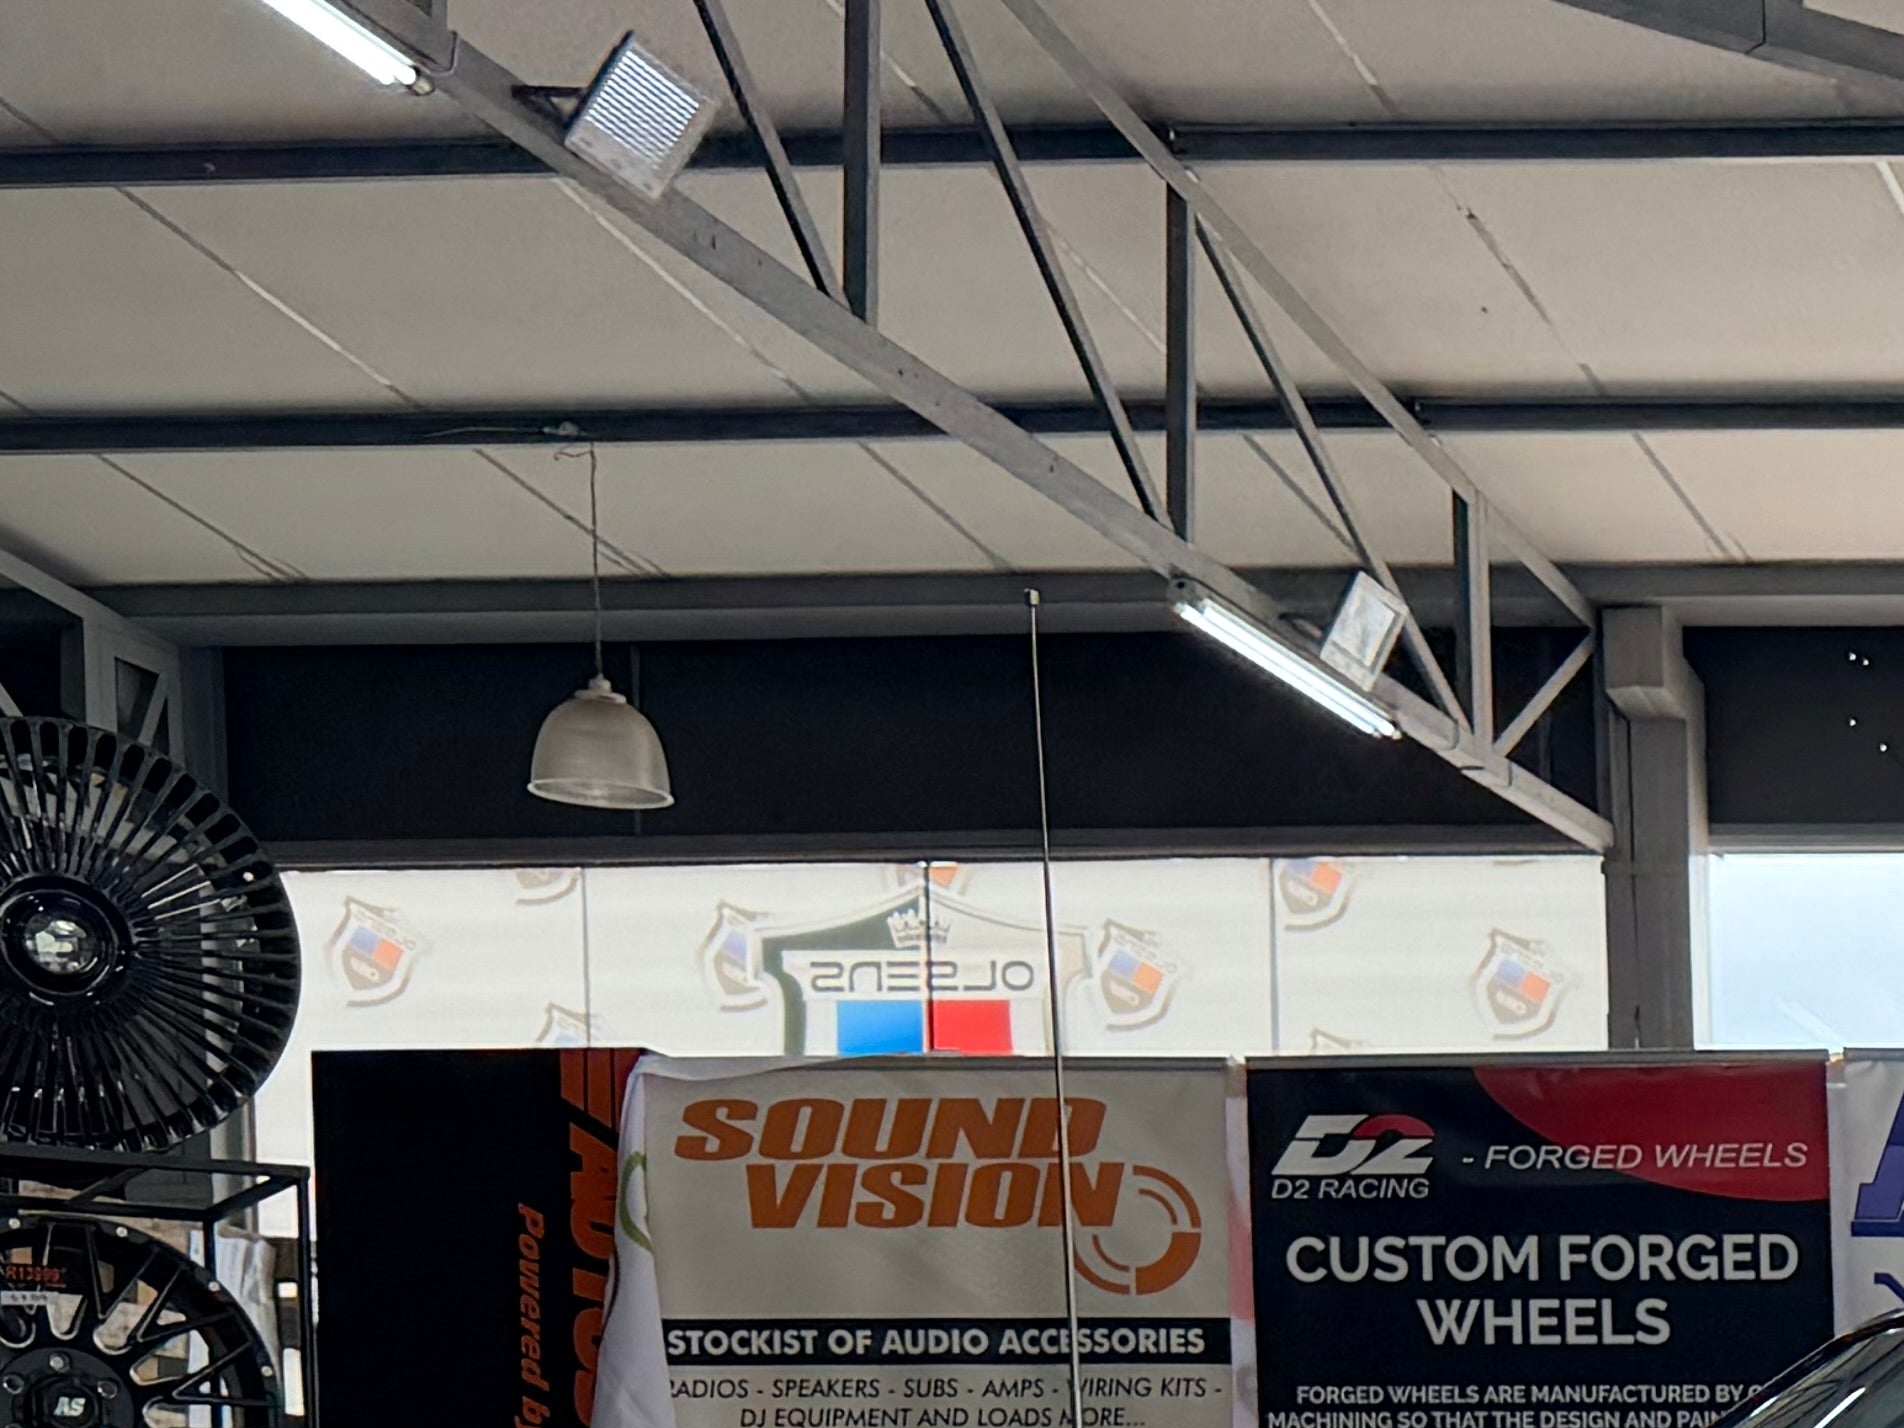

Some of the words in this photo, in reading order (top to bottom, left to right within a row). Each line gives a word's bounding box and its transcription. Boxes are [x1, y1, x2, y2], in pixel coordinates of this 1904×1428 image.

[673, 1097, 1106, 1160] SOUND
[1485, 1145, 1642, 1170] FORGED
[1655, 1142, 1808, 1168] WHEELS
[744, 1162, 1132, 1229] VISION
[1272, 1178, 1309, 1200] D2
[1317, 1178, 1429, 1200] RACING
[1286, 1234, 1539, 1282] CUSTOM
[1559, 1233, 1799, 1281] FORGED
[517, 1201, 550, 1393] Powered
[1416, 1298, 1671, 1345] WHEELS
[667, 1326, 818, 1358] STOCKIST
[828, 1326, 876, 1358] OF
[886, 1326, 990, 1358] AUDIO
[999, 1326, 1205, 1358] ACCESSORIES
[771, 1378, 880, 1399] SPEAKERS
[903, 1378, 958, 1399] SUBS
[982, 1378, 1045, 1399] AMPS
[1160, 1378, 1208, 1399] KITS
[1297, 1385, 1383, 1404] FORGED
[1388, 1385, 1479, 1404] WHEELS
[1483, 1385, 1526, 1404] ARE
[1531, 1384, 1709, 1403] MANUFACTURED
[1716, 1384, 1746, 1403] BY
[740, 1409, 767, 1428] DJ
[774, 1408, 913, 1428] EQUIPMENT
[917, 1408, 969, 1428] AND
[977, 1407, 1052, 1428] LOADS
